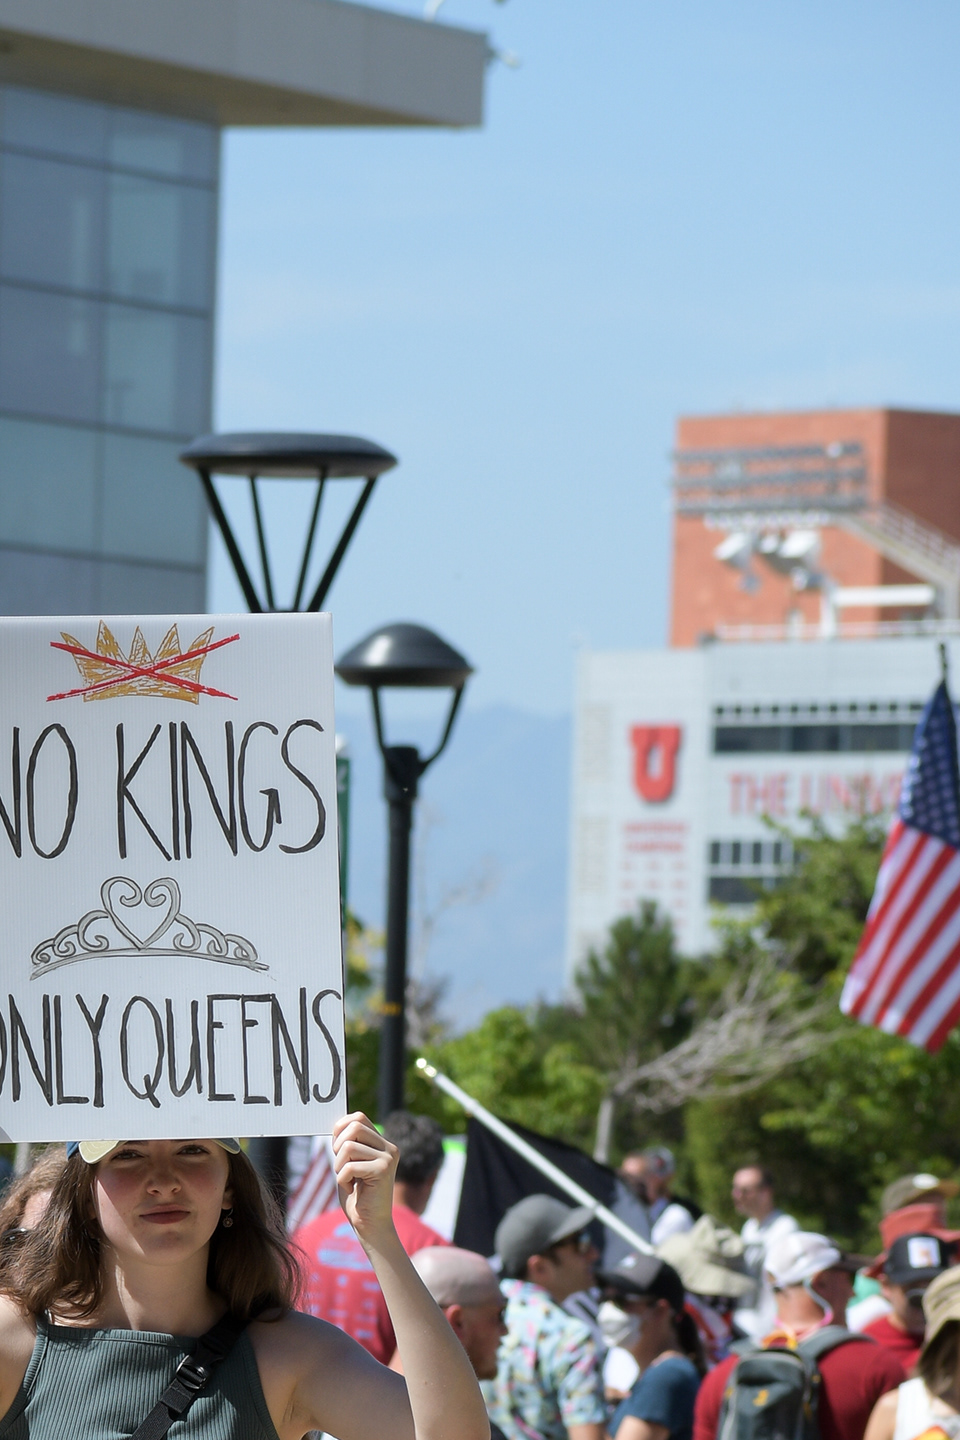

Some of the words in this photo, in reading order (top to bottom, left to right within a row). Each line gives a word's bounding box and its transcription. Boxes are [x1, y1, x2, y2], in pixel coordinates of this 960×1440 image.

[116, 718, 327, 862] KINGS
[628, 723, 683, 804] U
[729, 772, 787, 816] THE
[120, 988, 343, 1109] QUEENS
